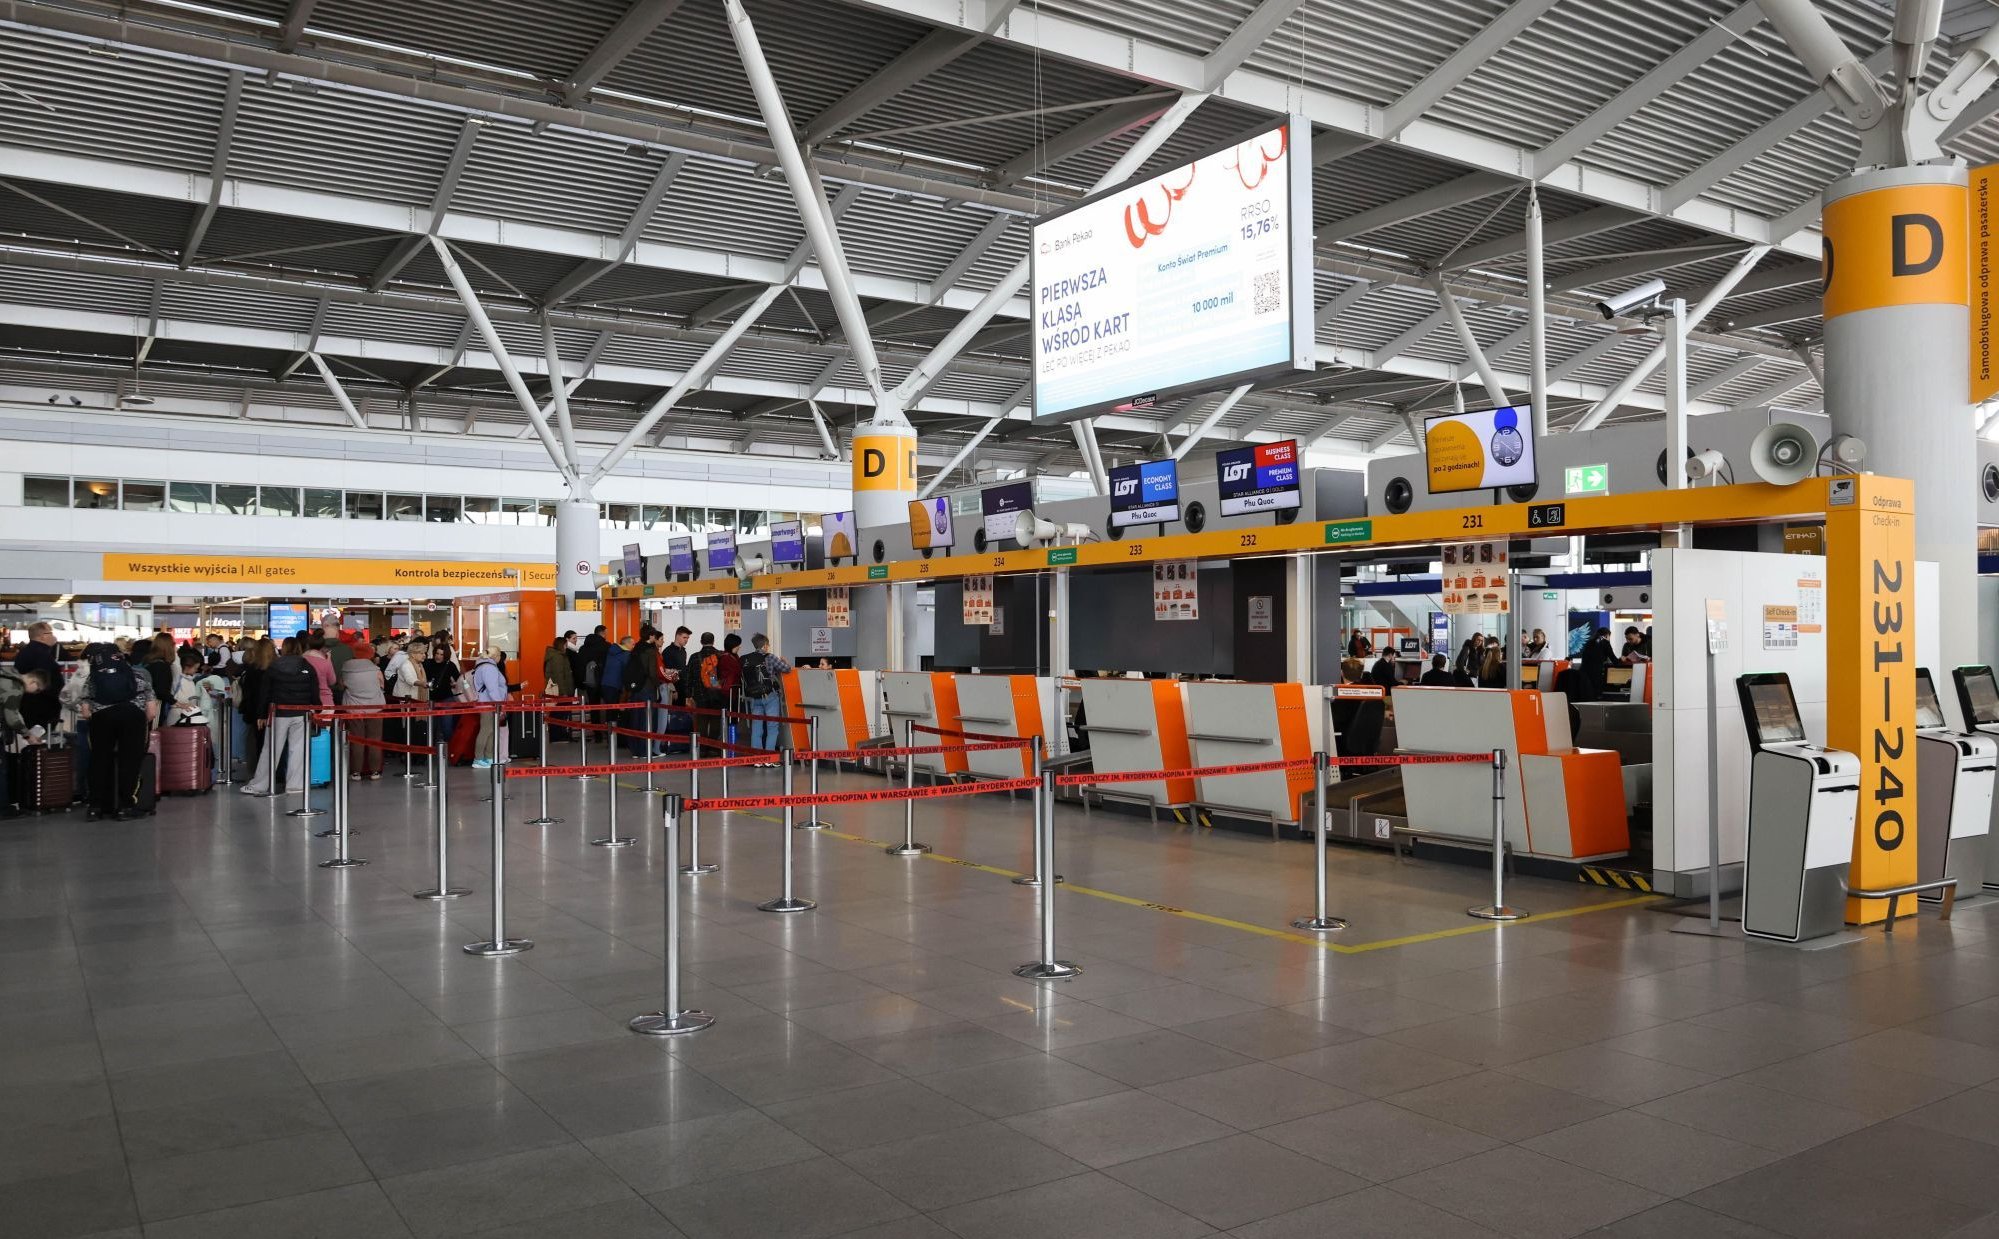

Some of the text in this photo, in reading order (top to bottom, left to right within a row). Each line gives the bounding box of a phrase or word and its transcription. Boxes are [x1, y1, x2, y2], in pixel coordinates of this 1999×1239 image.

[1241, 199, 1271, 220] RRSO
[1241, 214, 1279, 240] 15,76%
[1055, 229, 1093, 251] Bank Pekao
[1891, 213, 1944, 278] D
[1157, 260, 1177, 273] Konto
[1197, 244, 1228, 260] Premium
[1041, 267, 1108, 304] PIERWSZA
[1977, 177, 1991, 381] Samoobsługowa odprawa pasażerska
[1192, 291, 1234, 313] 10 000 mil
[1042, 301, 1082, 330] KLASA
[1042, 312, 1130, 354] WŚRÓD KART
[1265, 446, 1291, 455] BUSINESS
[863, 448, 886, 478] D
[1448, 461, 1480, 472] godzinach!
[1223, 463, 1252, 482] LOT
[1268, 467, 1293, 476] PREMIUM
[1143, 474, 1172, 484] ECONOMY
[1114, 479, 1138, 496] LOT
[1155, 482, 1172, 491] CLASS
[1244, 499, 1256, 508] Phu
[1872, 496, 1902, 509] Odprawa
[1462, 515, 1484, 529] 231
[1872, 515, 1900, 527] Check-in
[1240, 534, 1257, 547] 232
[1785, 532, 1817, 540] ETIHAD
[1129, 544, 1143, 556] 233
[920, 564, 929, 573] 235
[994, 557, 1005, 567] 234
[128, 563, 296, 577] Wszystkie wyjścia All gates
[395, 568, 440, 578] Kontrola
[827, 572, 835, 580] 236
[824, 751, 865, 759] FRYDERYKA
[973, 743, 998, 751] CHOPIN
[525, 767, 566, 775] FRYDERYKA
[568, 766, 599, 774] CHOPINA
[609, 764, 649, 772] WARSZAWIE
[660, 761, 687, 770] WARSAW
[721, 758, 745, 766] CHOPIN
[746, 756, 771, 764] AIRPORT
[1339, 756, 1358, 764] PORT
[1361, 756, 1397, 764] LOTNICZY
[1413, 754, 1455, 763] FRYDERYKA
[1456, 753, 1489, 762] CHOPINA
[1060, 775, 1077, 783] PORT
[1079, 774, 1109, 783] LOTNICZY
[1122, 772, 1157, 781] FRYDERYKA
[1158, 770, 1185, 778] CHOPINA
[1193, 767, 1227, 775] WARSZAWIE
[1236, 763, 1260, 772] WARSAW
[1289, 759, 1309, 767] CHOPIN
[690, 778, 1043, 810] ORT LOTNICZY IM. FRYDERYKA CHOPINA W WARSZAWIE WARSAW FRYDERYK CHOPIN
